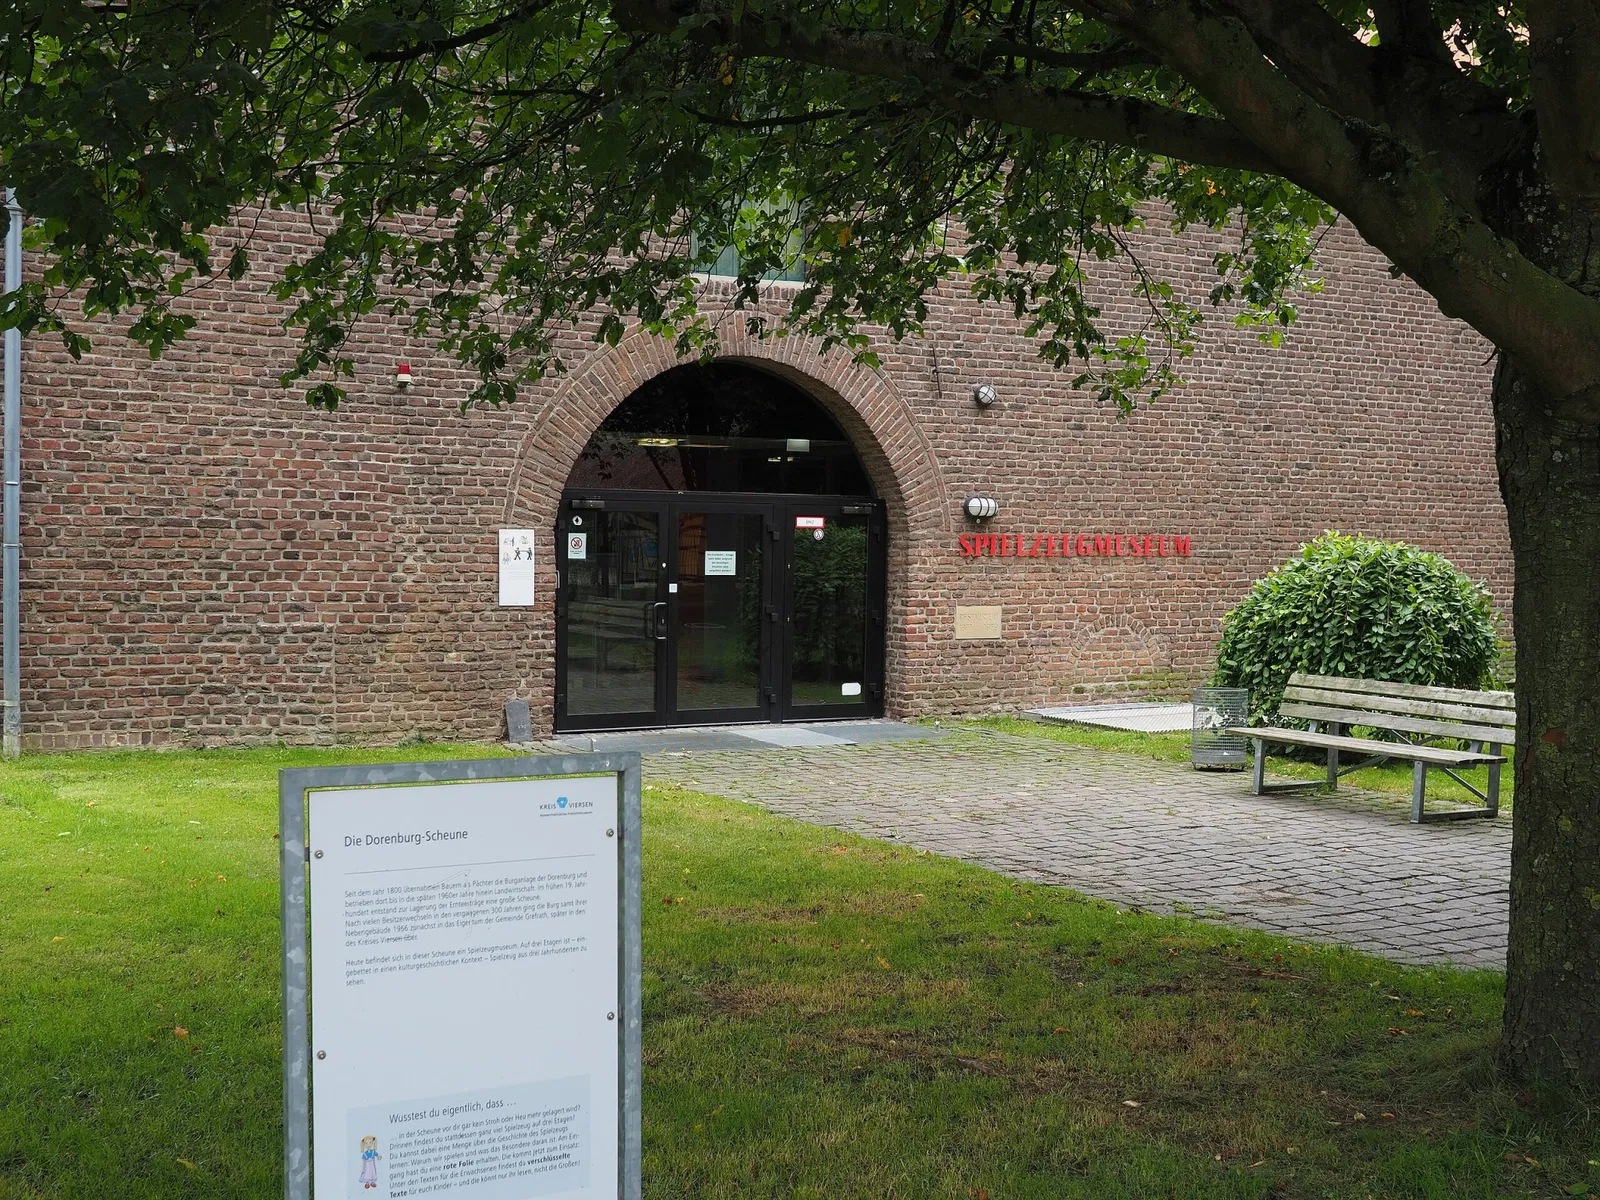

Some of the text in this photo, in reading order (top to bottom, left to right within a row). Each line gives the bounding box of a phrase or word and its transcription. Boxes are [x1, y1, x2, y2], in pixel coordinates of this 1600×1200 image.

[958, 534, 1191, 557] SPIELZEUGMUSEUM
[569, 801, 593, 809] VIERSEN
[344, 830, 468, 847] Die Dorenburg-Scheune
[344, 890, 357, 898] Seit
[372, 888, 385, 896] Jahr
[472, 879, 494, 887] Pächter
[504, 876, 536, 886] Burganlage
[547, 873, 576, 881] Dorenburg
[576, 871, 588, 879] und
[344, 899, 374, 908] betrieben
[406, 895, 415, 903] die
[416, 894, 436, 903] späten
[438, 892, 459, 900] 1960er
[459, 890, 474, 898] Jahre
[475, 888, 493, 897] hinein
[545, 883, 563, 891] frühen
[345, 909, 369, 917] hundert
[370, 906, 397, 915] entstand
[409, 905, 437, 913] Lagerung
[499, 896, 515, 906] große
[345, 919, 362, 927] Nach
[363, 918, 381, 926] vielen
[382, 913, 432, 924] Besitzerwechseln
[440, 911, 452, 919] den
[491, 906, 503, 914] 300
[503, 905, 522, 913] Jahren
[522, 903, 535, 913] ging
[536, 902, 545, 910] die
[546, 902, 559, 910] Burg
[345, 926, 391, 937] Nebengebäude
[393, 924, 408, 932] 1966
[410, 922, 436, 931] zunächst
[445, 920, 455, 928] das
[495, 914, 524, 923] Gemeinde
[550, 910, 567, 919] später
[574, 908, 586, 916] den
[345, 939, 357, 947] des
[358, 937, 380, 946] Kreises
[365, 955, 390, 964] befindet
[392, 954, 404, 962] sich
[412, 952, 430, 960] dieser
[431, 950, 456, 958] Scheune
[457, 947, 467, 955] ein
[520, 940, 530, 948] Auf
[531, 939, 542, 947] drei
[543, 939, 562, 947] Etagen
[576, 935, 587, 943] ein-
[345, 967, 372, 978] gebettet
[398, 958, 460, 971] kulturgeschichtlichen
[460, 956, 483, 964] Kontext
[489, 953, 516, 963] Spielzeug
[528, 949, 540, 957] drei
[540, 946, 579, 956] Jahrhunderten
[389, 1101, 504, 1124] Wusstest du eigentlich, dass
[405, 1131, 416, 1139] der
[416, 1128, 441, 1137] Scheune
[461, 1124, 471, 1132] gar
[472, 1120, 484, 1128] kein
[485, 1117, 501, 1126] Stroh
[500, 1116, 514, 1124] oder
[527, 1111, 541, 1120] mehr
[542, 1108, 565, 1120] gelagert
[565, 1105, 581, 1114] wird?
[389, 1115, 575, 1151] Drinnen findest stattdessen ganz viel Spielzeug auf drei Etagen!
[399, 1127, 569, 1159] kannst dabei eine Menge über die Geschichte des Spielzeugs
[389, 1172, 405, 1181] gang
[406, 1169, 419, 1177] hast
[429, 1165, 442, 1173] eine
[443, 1163, 457, 1171] rote
[459, 1159, 474, 1168] Folie
[501, 1153, 511, 1161] Die
[512, 1151, 532, 1159] kommt
[532, 1148, 545, 1158] jetzt
[410, 1158, 431, 1167] Warum
[432, 1155, 443, 1163] wir
[443, 1152, 464, 1163] spielen
[466, 1149, 477, 1158] und
[490, 1146, 501, 1154] das
[502, 1141, 531, 1152] Besondere
[531, 1139, 548, 1147] daran
[568, 1133, 580, 1141] Ein-
[389, 1181, 406, 1189] Unter
[420, 1176, 439, 1184] Texten
[440, 1173, 449, 1181] für
[450, 1171, 459, 1179] die
[460, 1166, 497, 1177] Erwachsenen
[498, 1162, 517, 1171] findest
[527, 1153, 571, 1166] verschlüsselte
[390, 1190, 408, 1198] Texte
[408, 1187, 418, 1195] für
[418, 1185, 433, 1194] euch
[433, 1182, 453, 1191] Kinder
[459, 1178, 470, 1187] und
[471, 1177, 479, 1185] die
[480, 1175, 497, 1183] könnt
[508, 1171, 516, 1179] ihr
[534, 1166, 548, 1175] nicht
[548, 1164, 557, 1172] die
